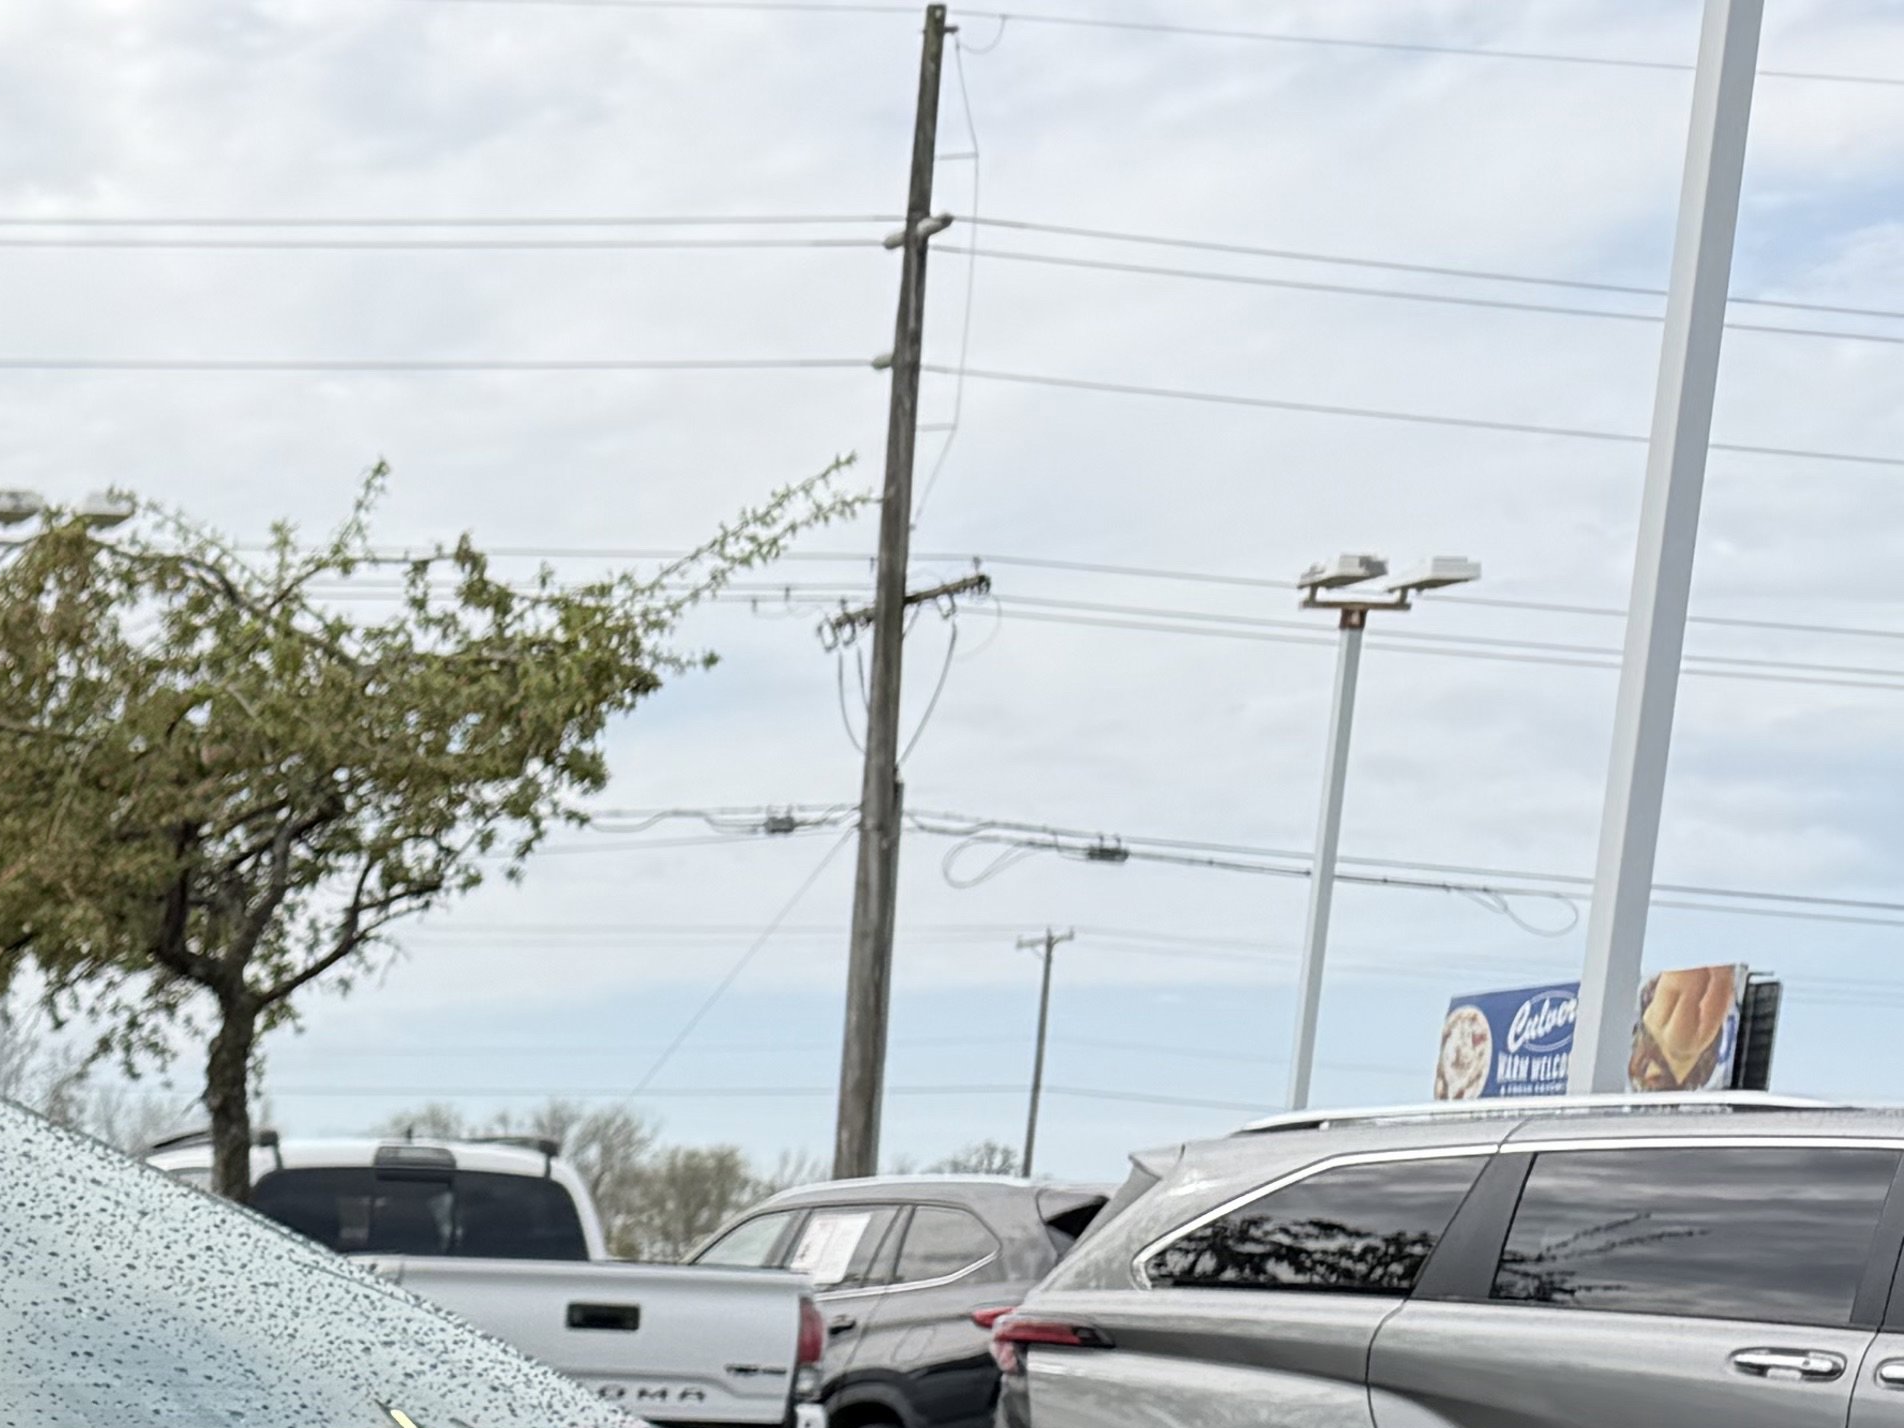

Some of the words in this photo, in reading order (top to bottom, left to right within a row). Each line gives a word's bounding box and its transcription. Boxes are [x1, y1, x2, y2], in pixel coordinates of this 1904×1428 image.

[1506, 997, 1578, 1053] Culver
[1497, 1051, 1529, 1083] WARM
[1531, 1051, 1569, 1081] WELCO
